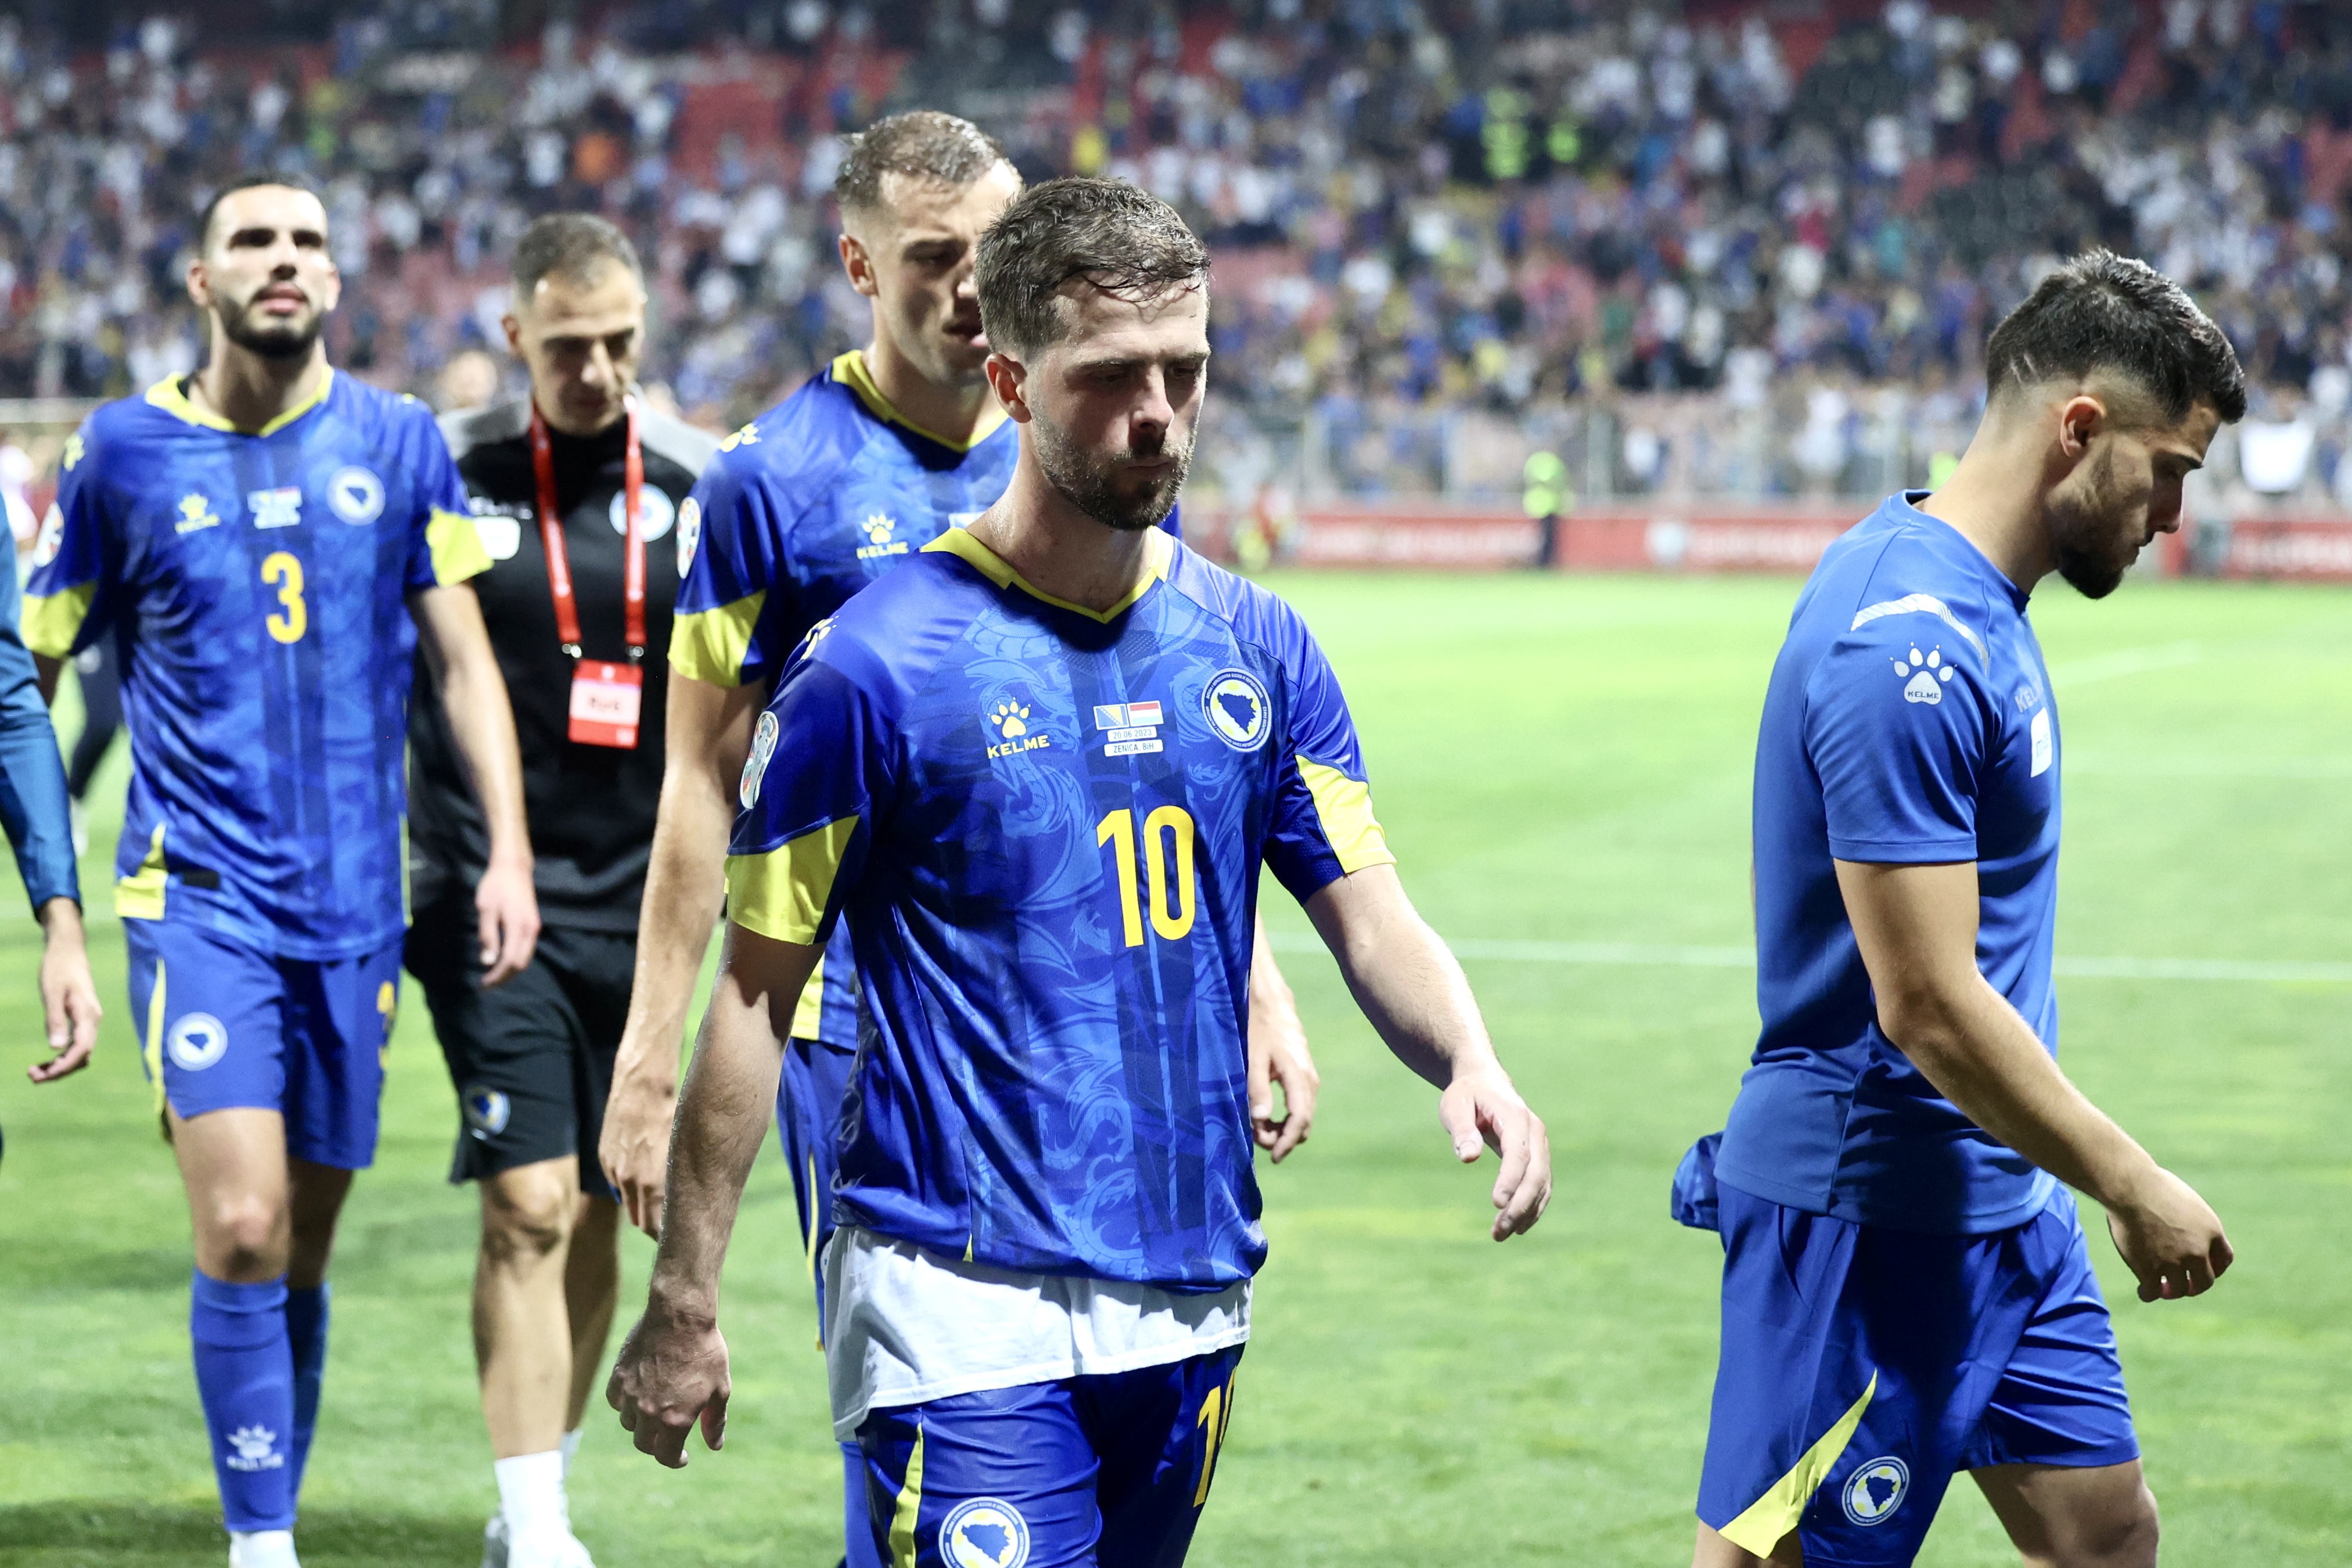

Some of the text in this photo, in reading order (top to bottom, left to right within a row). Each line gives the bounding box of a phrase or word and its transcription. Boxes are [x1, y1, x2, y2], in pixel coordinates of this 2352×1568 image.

[261, 551, 308, 644] 3
[1907, 691, 1940, 699] KELME
[1113, 729, 1152, 739] 20.06.2023
[987, 735, 1050, 759] KELME
[1142, 742, 1155, 750] BiH
[1096, 805, 1195, 947] 10
